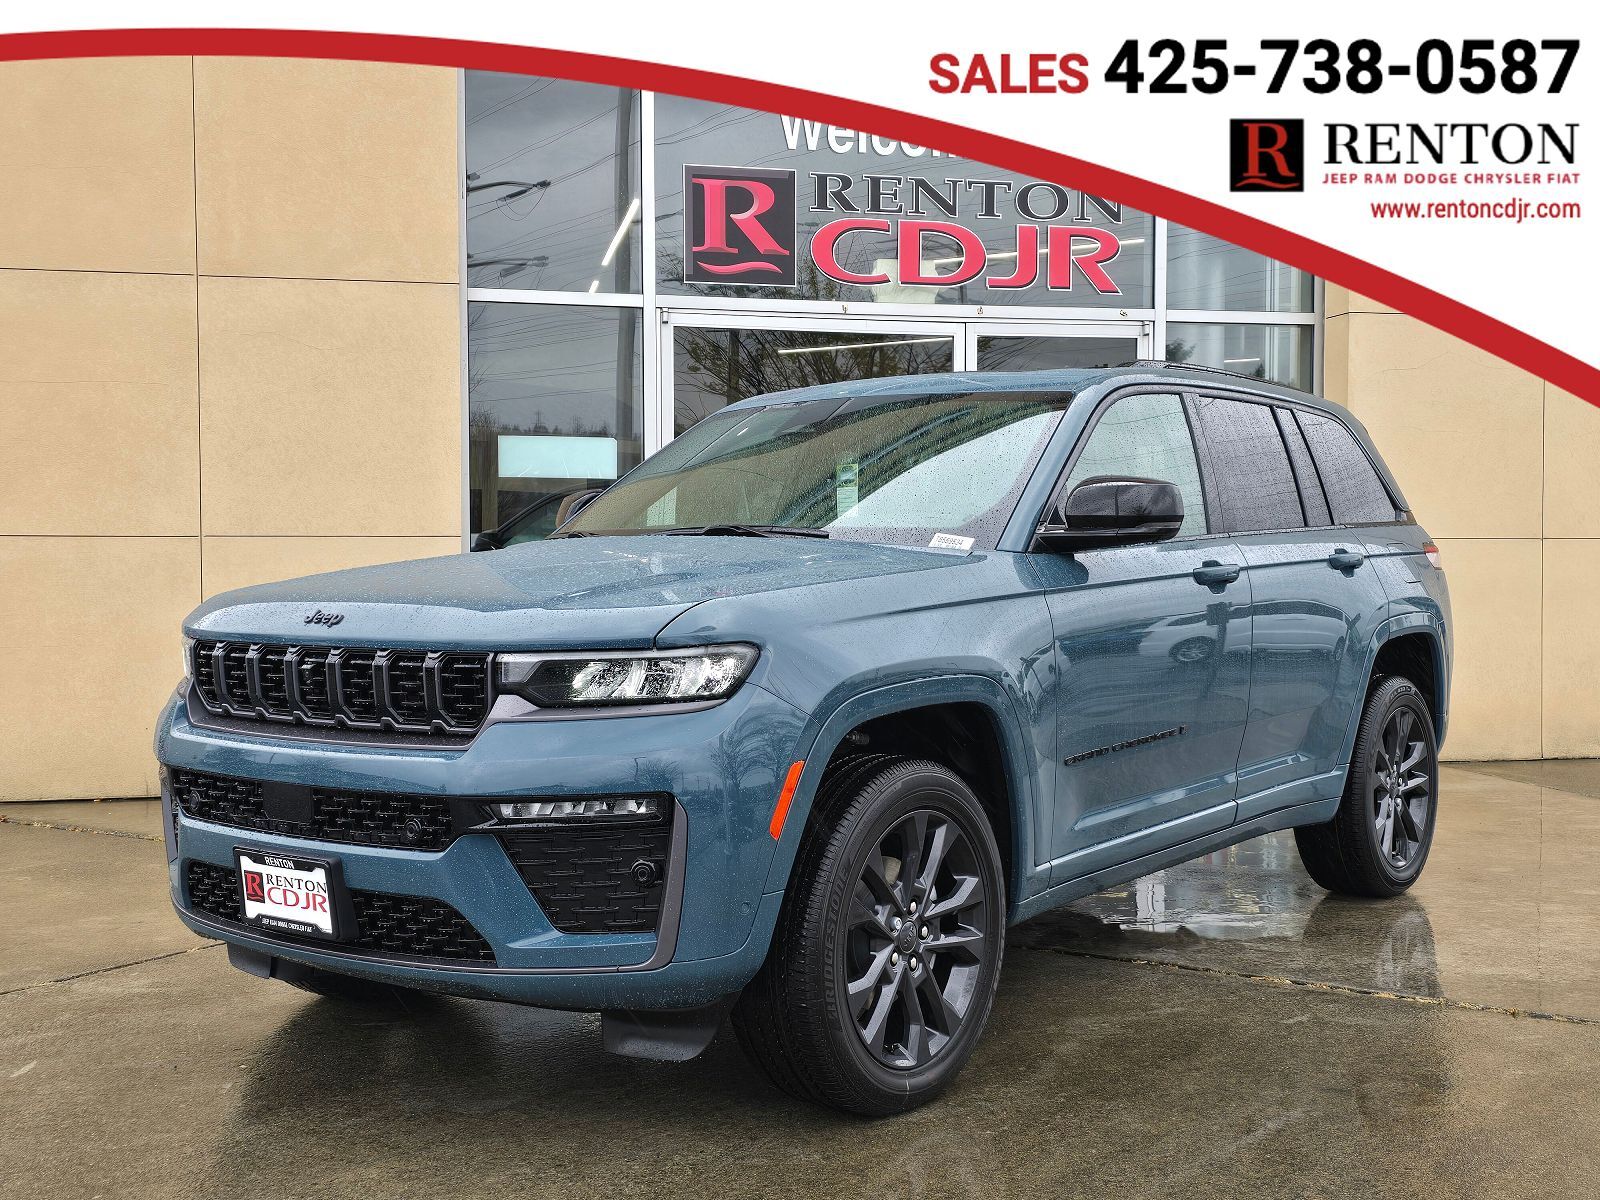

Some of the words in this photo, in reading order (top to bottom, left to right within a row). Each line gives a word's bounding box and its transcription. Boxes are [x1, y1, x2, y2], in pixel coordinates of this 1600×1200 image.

[808, 172, 1123, 224] RENTON
[810, 218, 1123, 296] CDJR
[304, 610, 345, 628] Jeep
[265, 857, 295, 869] RENTON
[266, 873, 327, 894] RENTON
[266, 886, 328, 913] CDJR
